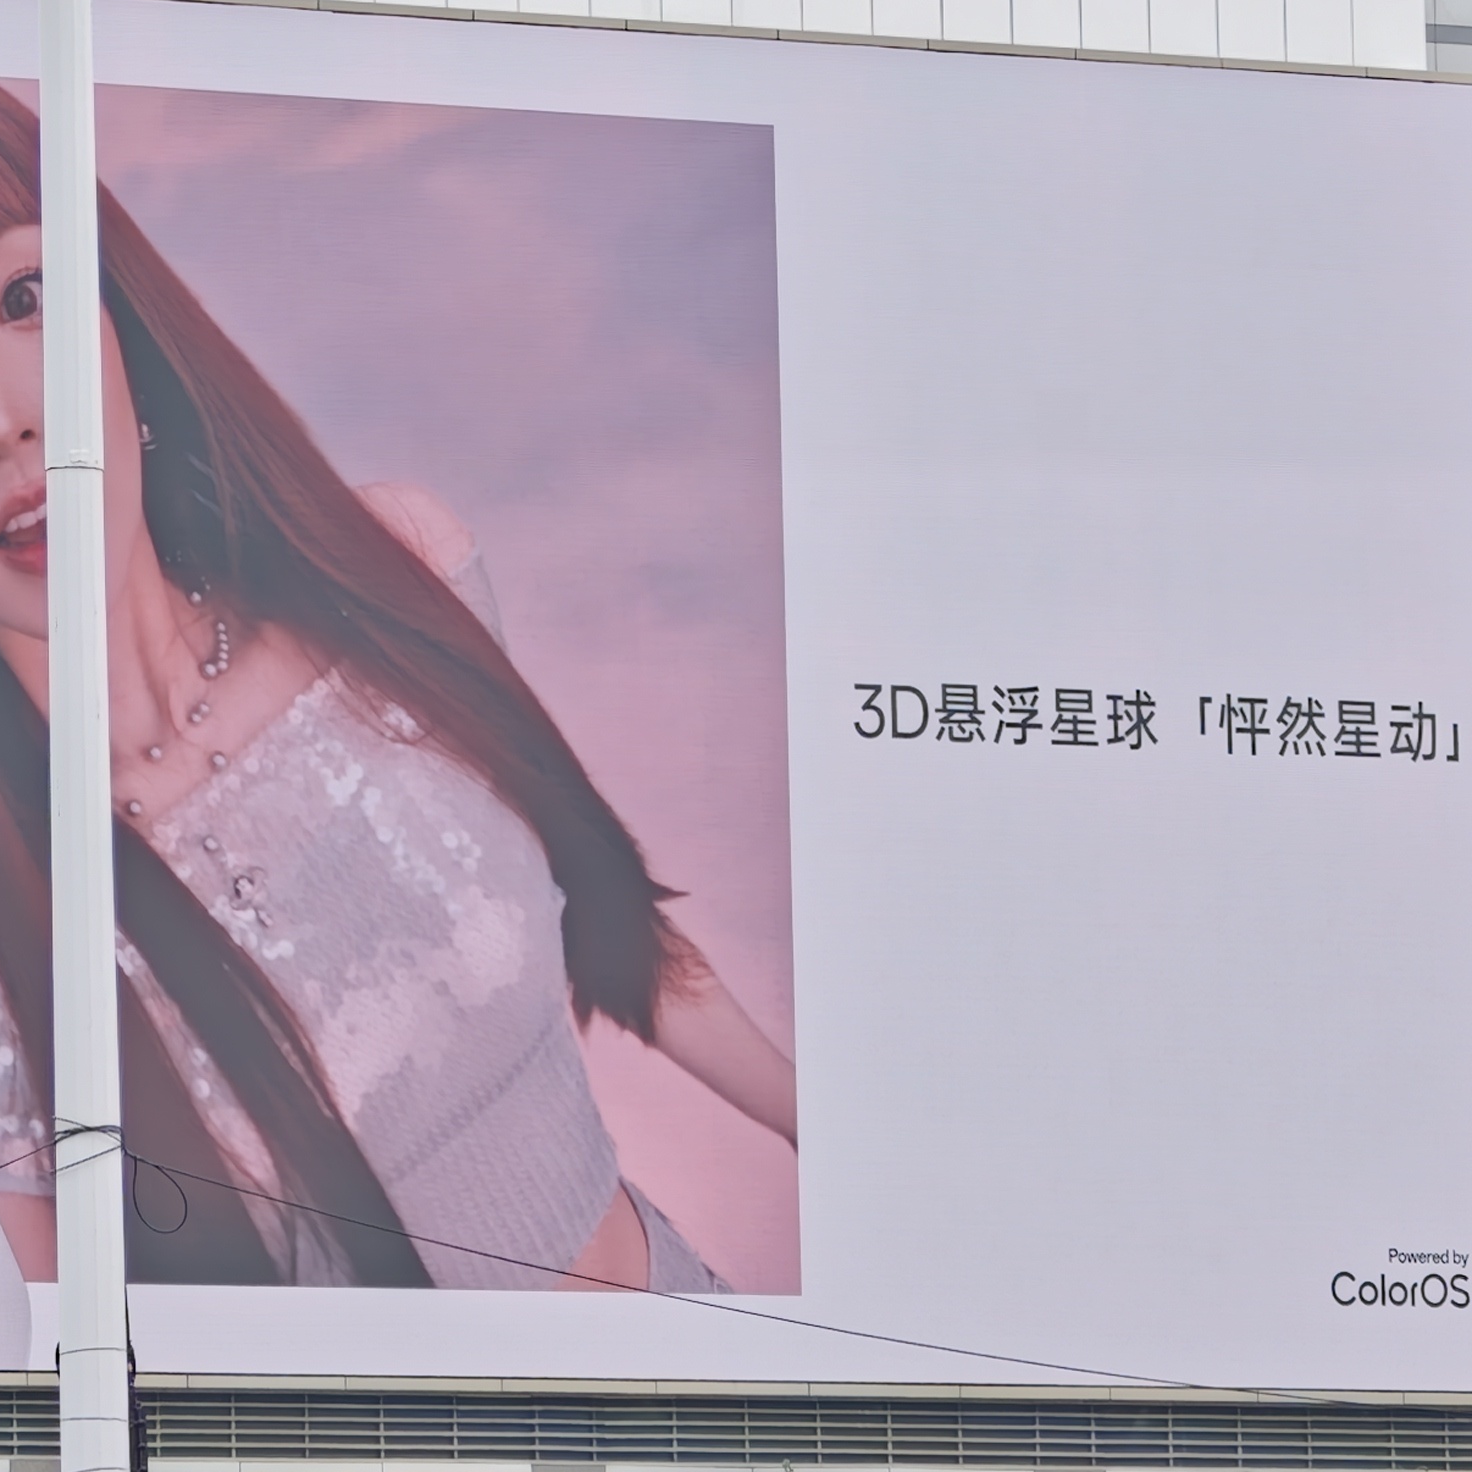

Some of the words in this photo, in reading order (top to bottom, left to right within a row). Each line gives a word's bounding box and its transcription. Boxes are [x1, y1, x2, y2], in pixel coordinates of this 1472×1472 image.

[1388, 1247, 1449, 1265] Powered
[1452, 1248, 1470, 1269] by
[1330, 1271, 1471, 1309] ColorOS
